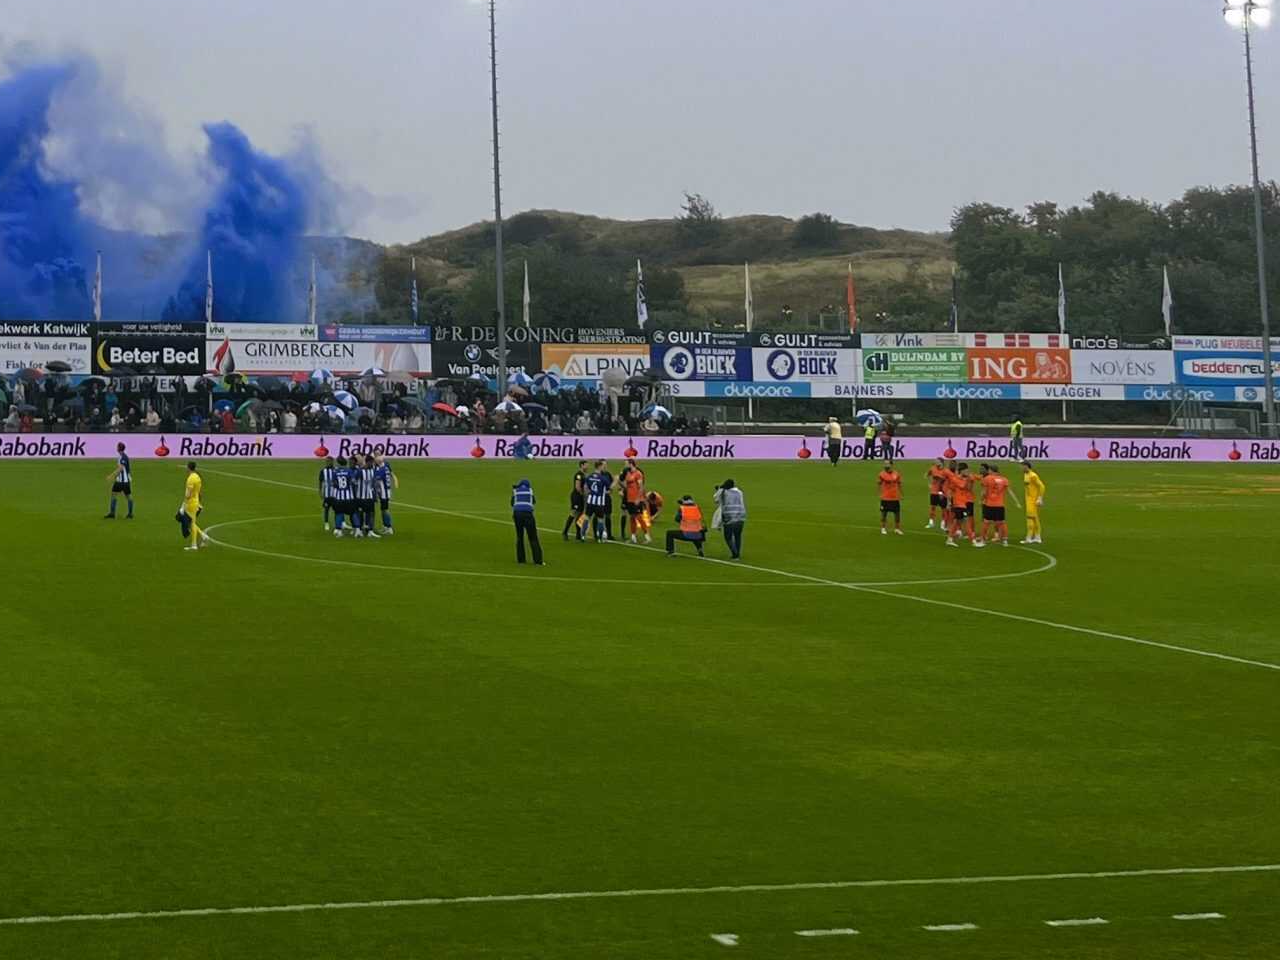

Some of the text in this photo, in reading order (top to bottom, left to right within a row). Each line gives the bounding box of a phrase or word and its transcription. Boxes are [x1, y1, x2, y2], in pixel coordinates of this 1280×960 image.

[451, 326, 575, 343] R. DE KONING
[668, 331, 712, 344] GUIJT
[774, 334, 818, 347] GUIJT
[895, 334, 924, 346] Vink
[1072, 335, 1119, 349] nico's
[24, 342, 32, 351] &
[34, 342, 50, 351] Van
[52, 341, 67, 351] der
[69, 342, 87, 351] Plas
[244, 342, 355, 358] GRIMBERGEN
[1195, 339, 1218, 349] PLUG
[1220, 339, 1265, 350] MEUBELE
[109, 346, 200, 365] Beter Bed
[891, 352, 947, 362] DUIJNDAM
[5, 359, 27, 369] Fish
[28, 359, 43, 369] for
[448, 363, 471, 375] Van
[695, 355, 737, 374] BOCK
[798, 357, 838, 376] BOCK
[971, 356, 1029, 380] ING
[1090, 360, 1156, 377] NOVENS
[724, 382, 793, 397] duocore
[834, 385, 894, 396] BANNERS
[936, 384, 1003, 399] duocore
[1044, 386, 1101, 398] VLAGGEN
[180, 437, 273, 457] Rabobank
[340, 438, 430, 457] Rabobank
[494, 438, 584, 457] Raobank
[647, 439, 735, 458] Rabobank
[1109, 441, 1192, 459] Rabobank
[337, 476, 347, 489] 18
